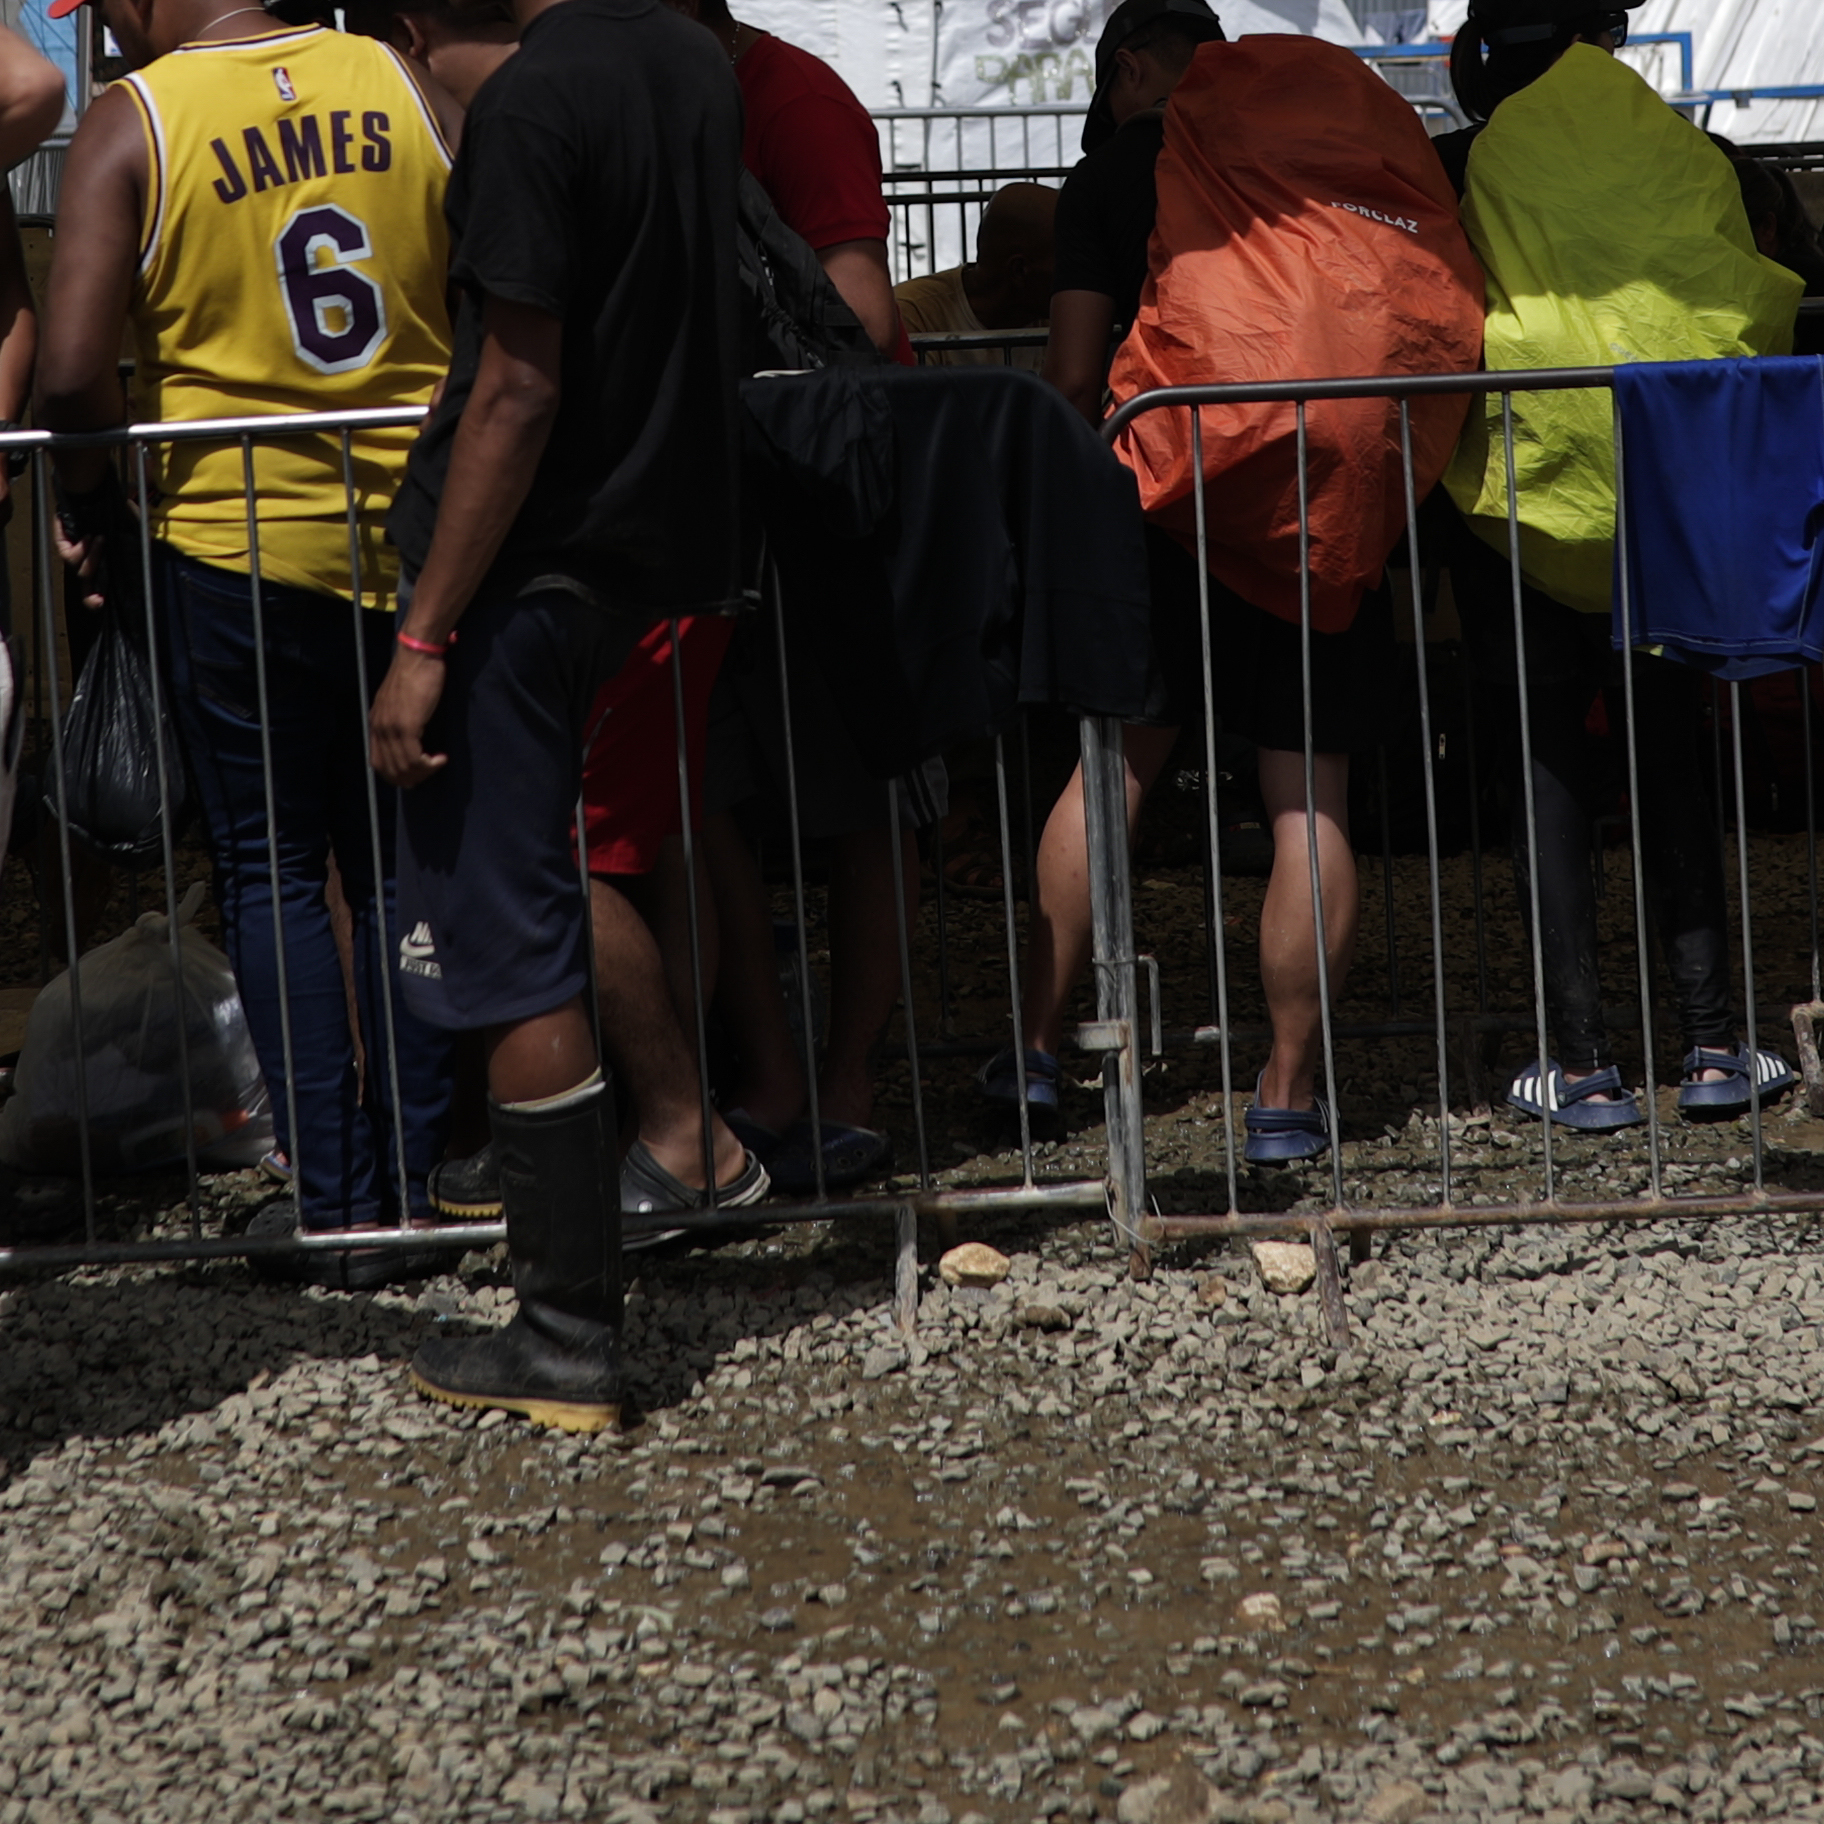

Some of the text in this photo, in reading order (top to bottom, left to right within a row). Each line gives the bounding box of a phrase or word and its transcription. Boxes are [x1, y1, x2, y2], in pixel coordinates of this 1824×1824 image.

[209, 110, 392, 205] JAMES
[1331, 201, 1419, 234] FORCLAZ
[274, 203, 388, 375] 6
